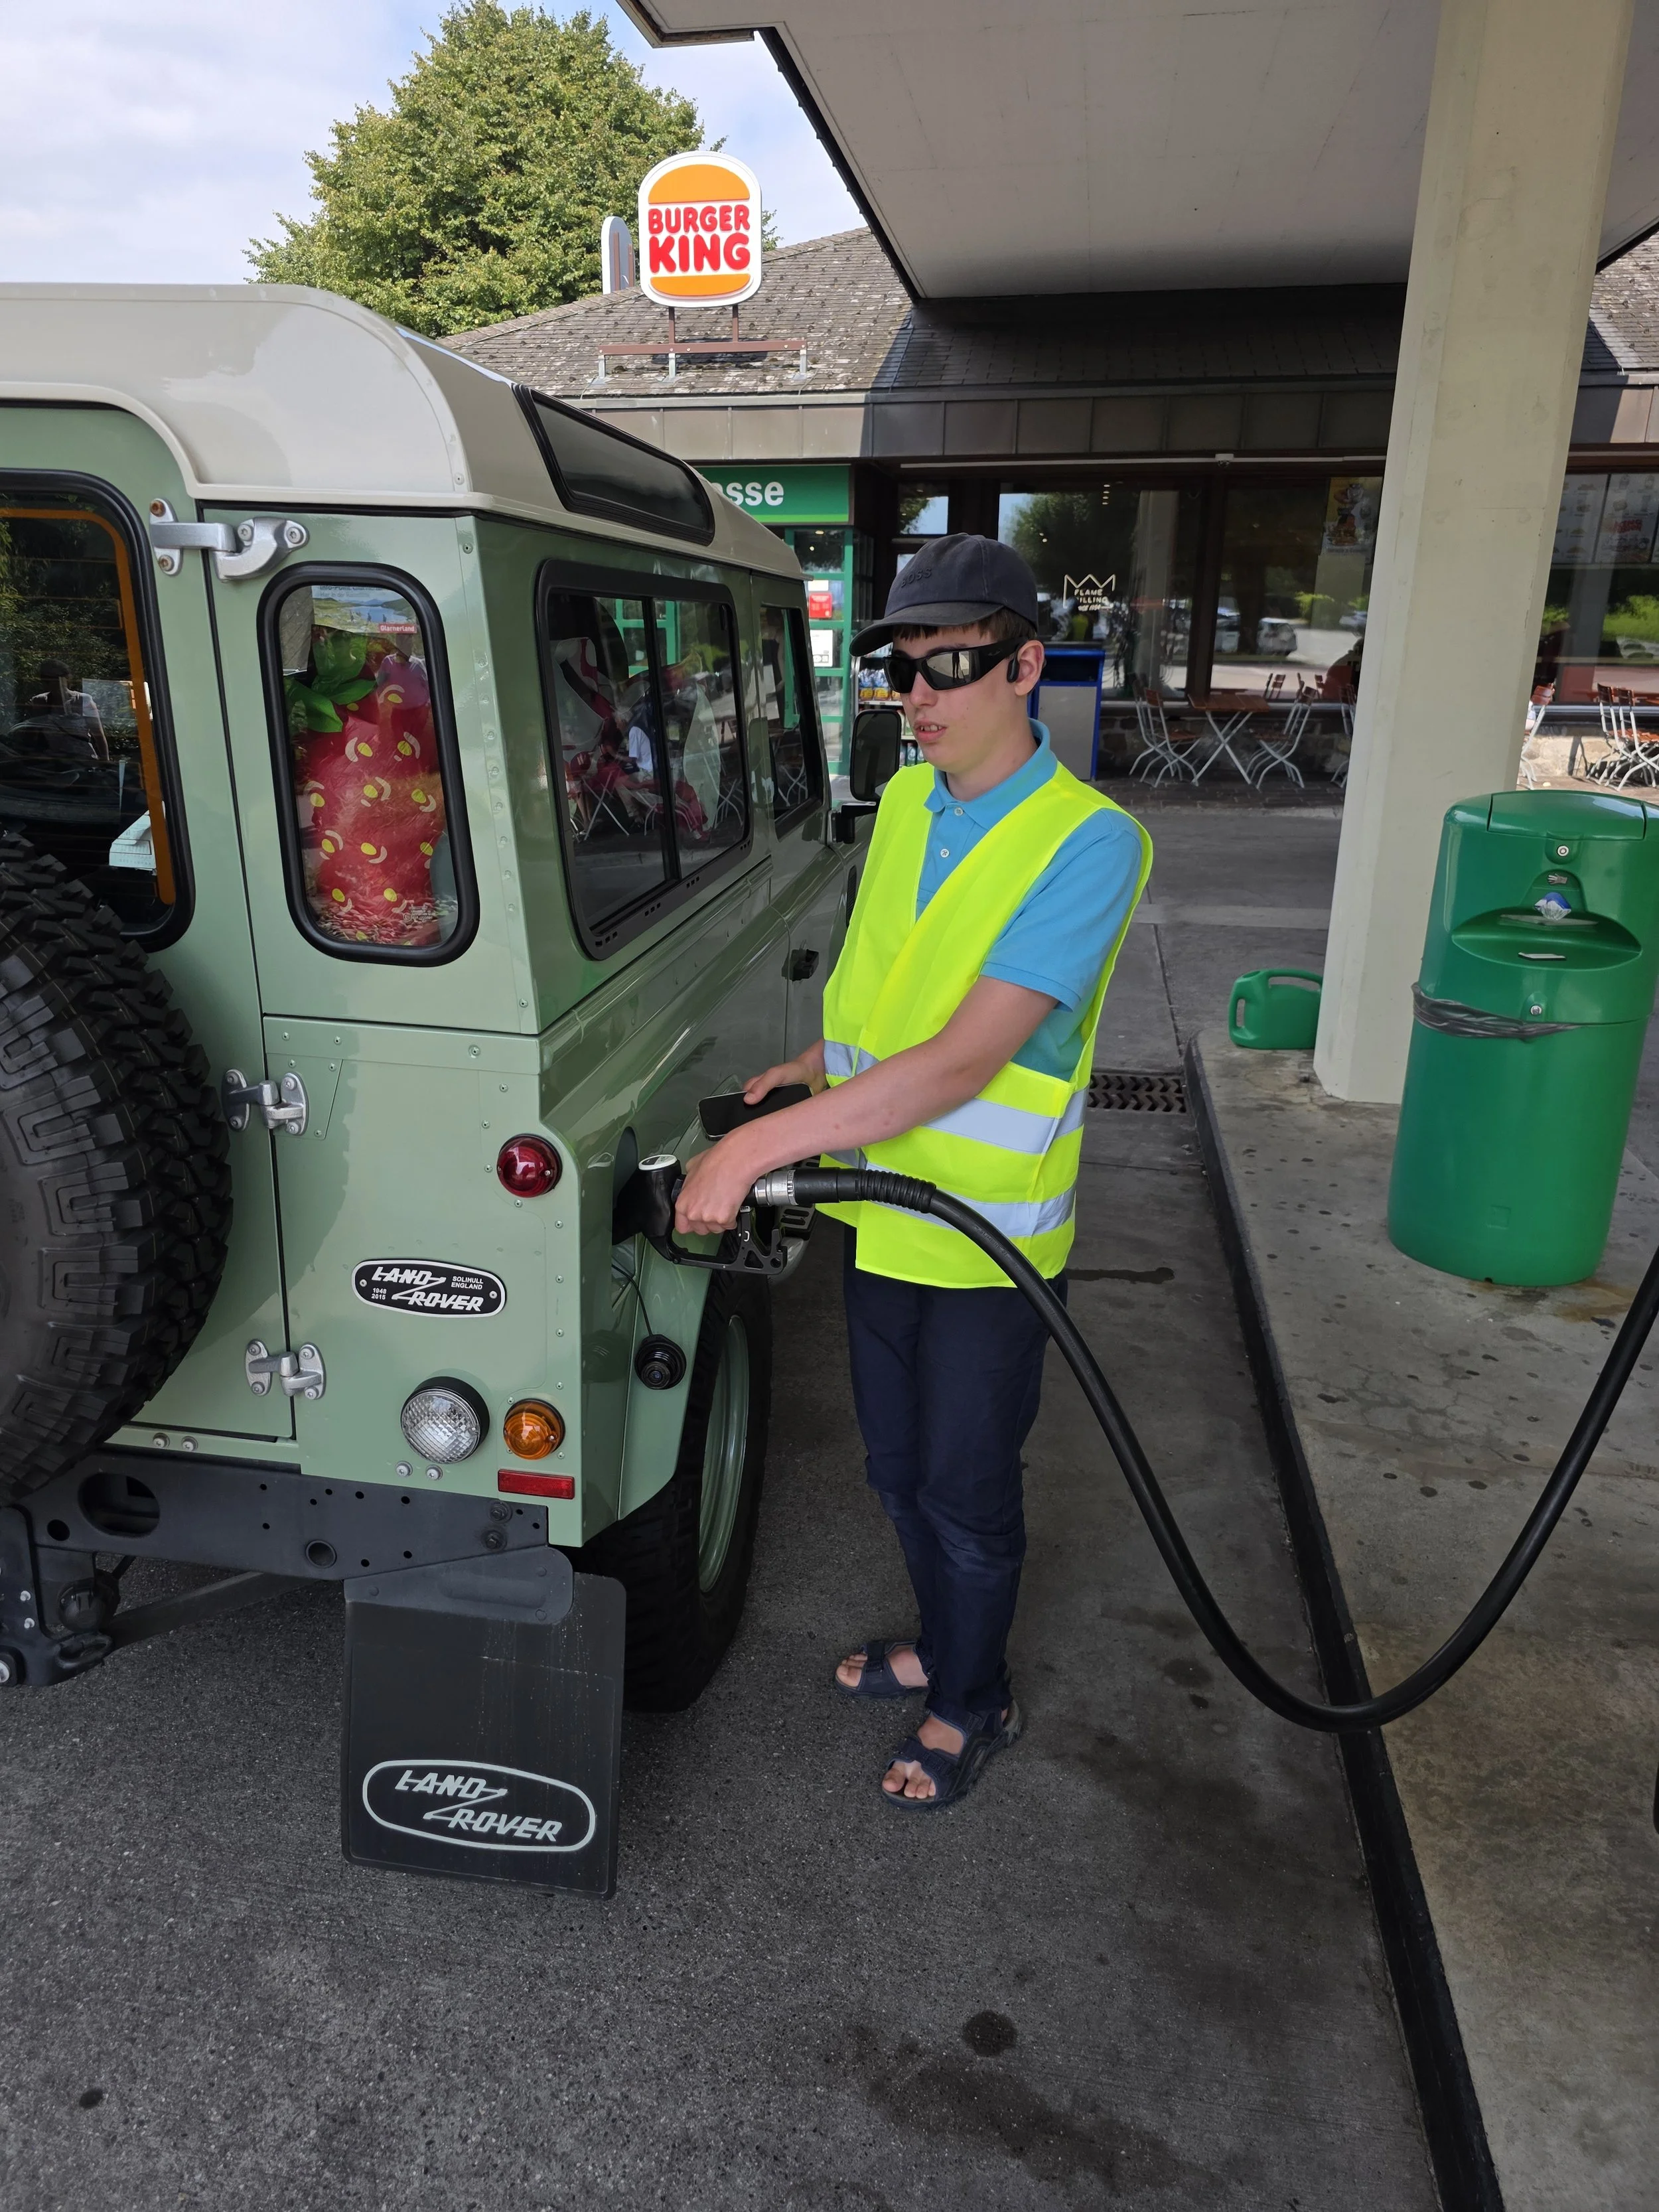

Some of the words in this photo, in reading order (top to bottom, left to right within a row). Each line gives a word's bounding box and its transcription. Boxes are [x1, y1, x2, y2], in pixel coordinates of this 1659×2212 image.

[648, 204, 751, 234] BURGER
[649, 232, 751, 273] KING
[372, 1266, 433, 1286] LAND
[452, 1276, 484, 1285] SOLIHULL
[407, 1291, 484, 1312] ROVER
[394, 1769, 488, 1799] LAND
[448, 1808, 563, 1842] ROVER
